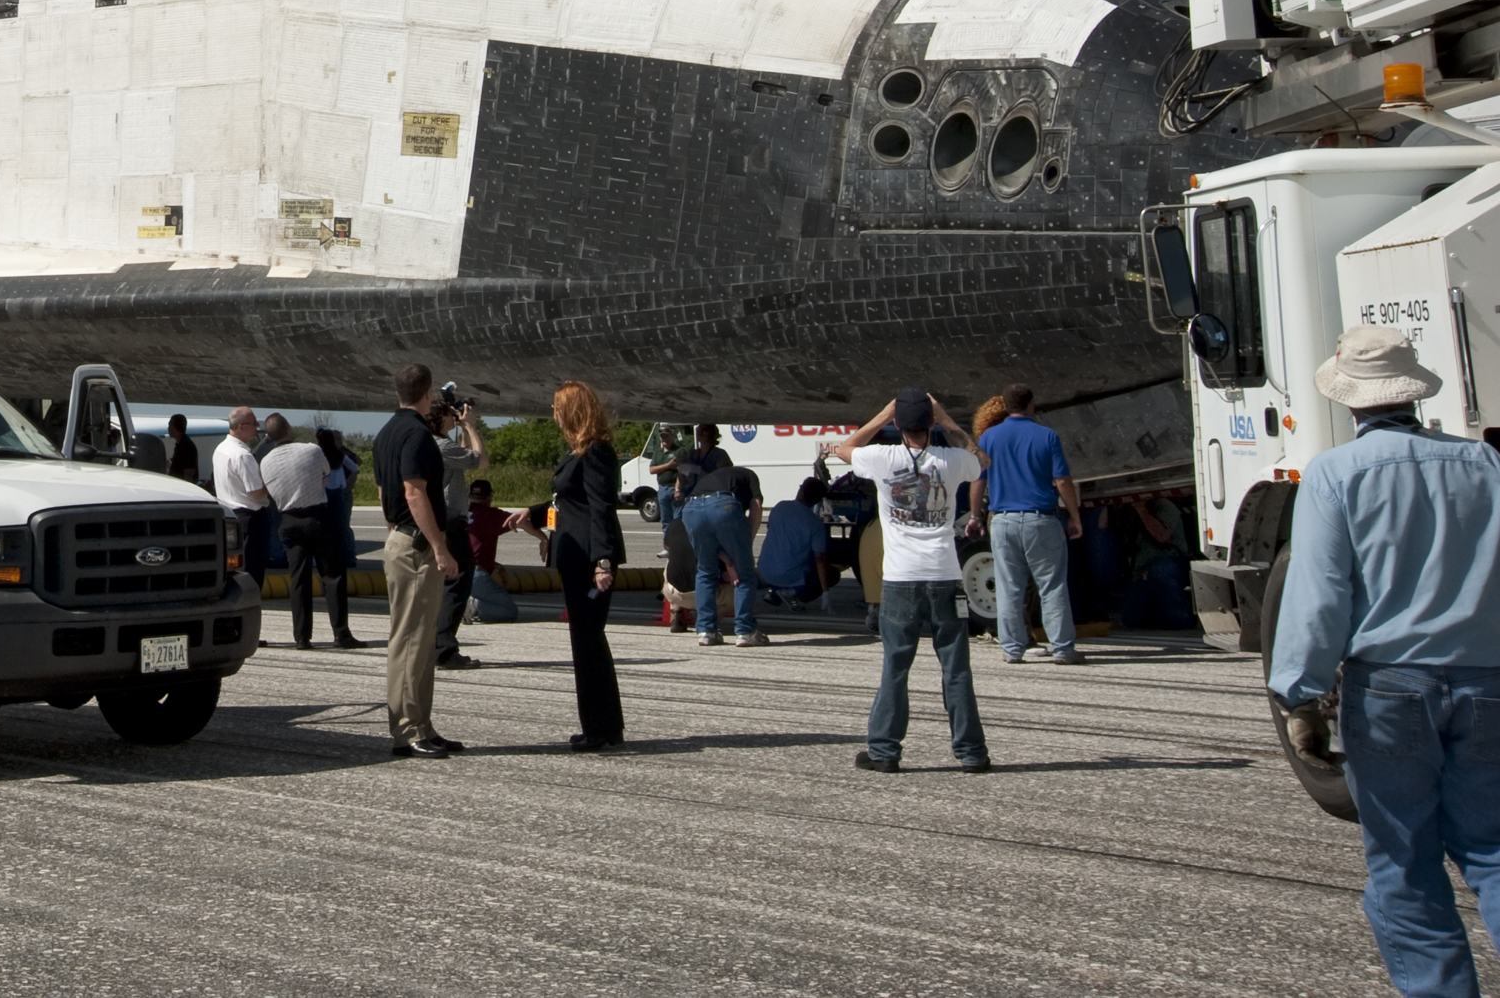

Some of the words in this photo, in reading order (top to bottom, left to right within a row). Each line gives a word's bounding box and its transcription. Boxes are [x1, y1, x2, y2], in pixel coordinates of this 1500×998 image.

[412, 115, 427, 124] CUT
[431, 117, 450, 126] HERE
[420, 126, 436, 134] FOR
[405, 135, 449, 145] EMERGENCY
[413, 145, 443, 155] RESCUE
[1360, 305, 1376, 325] HE
[1379, 299, 1430, 324] 907-405
[1407, 327, 1424, 342] LIFT
[732, 424, 757, 433] NASA
[1229, 415, 1256, 440] USA
[820, 442, 843, 454] Min
[144, 550, 166, 562] Ford
[156, 644, 186, 664] 2761A
